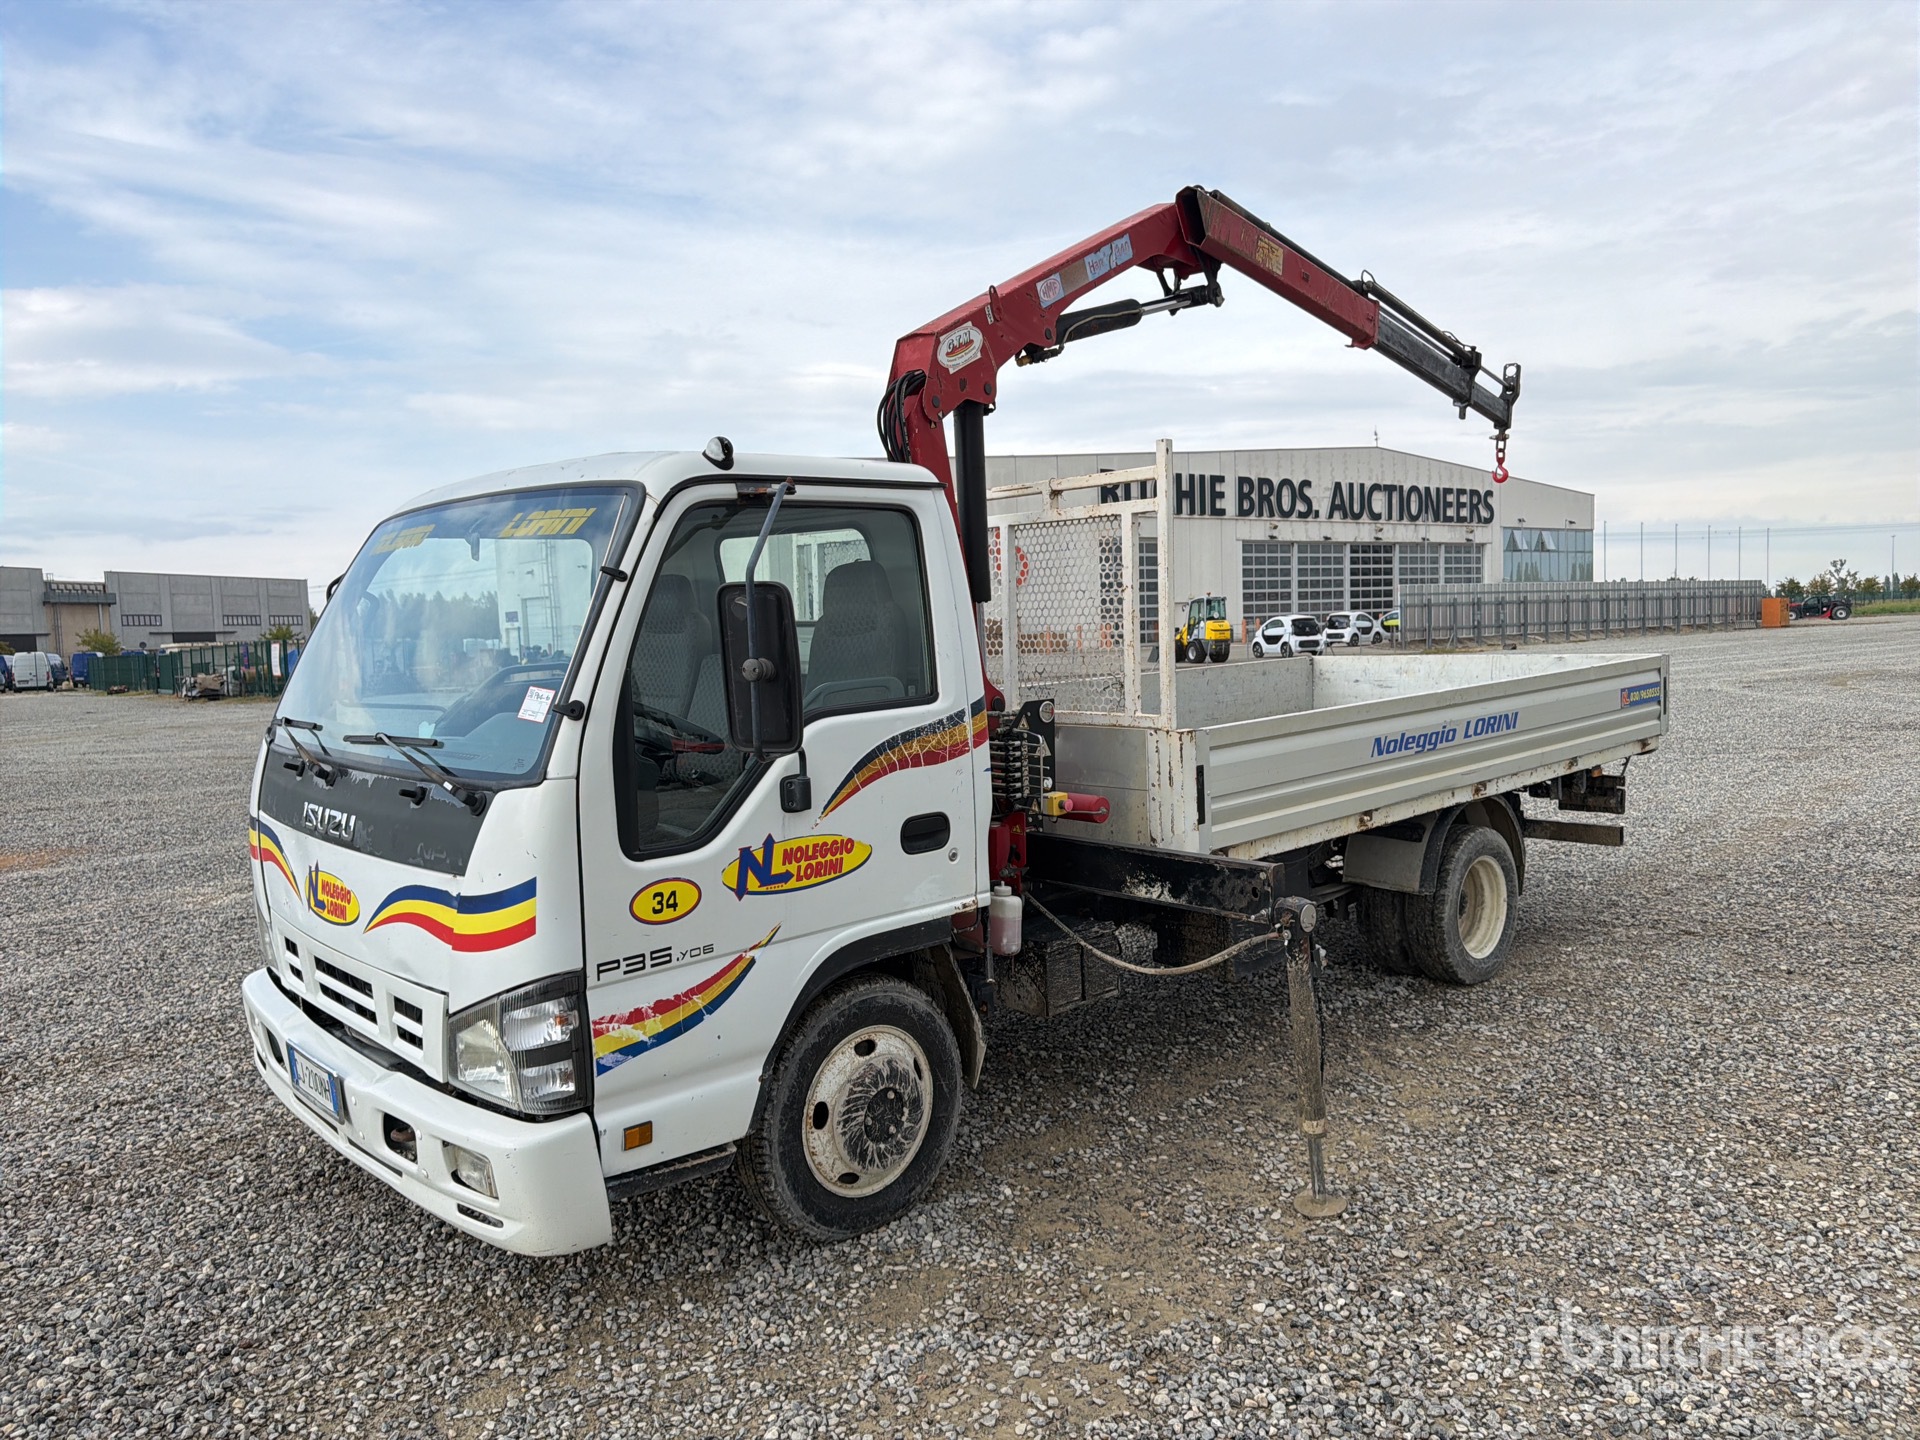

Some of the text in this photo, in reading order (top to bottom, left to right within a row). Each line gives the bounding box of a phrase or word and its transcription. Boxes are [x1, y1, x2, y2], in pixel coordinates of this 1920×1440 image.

[1237, 476, 1320, 519] BROS.
[1327, 481, 1495, 525] AUCTIONEERS
[1370, 711, 1519, 758] Noleggio LORINI
[302, 801, 357, 841] ISUZU
[782, 837, 855, 867] NOLEGGIO
[795, 857, 844, 883] LORINI
[321, 879, 352, 906] NOLEGGIO
[651, 890, 679, 915] 34
[327, 898, 347, 922] LORINI
